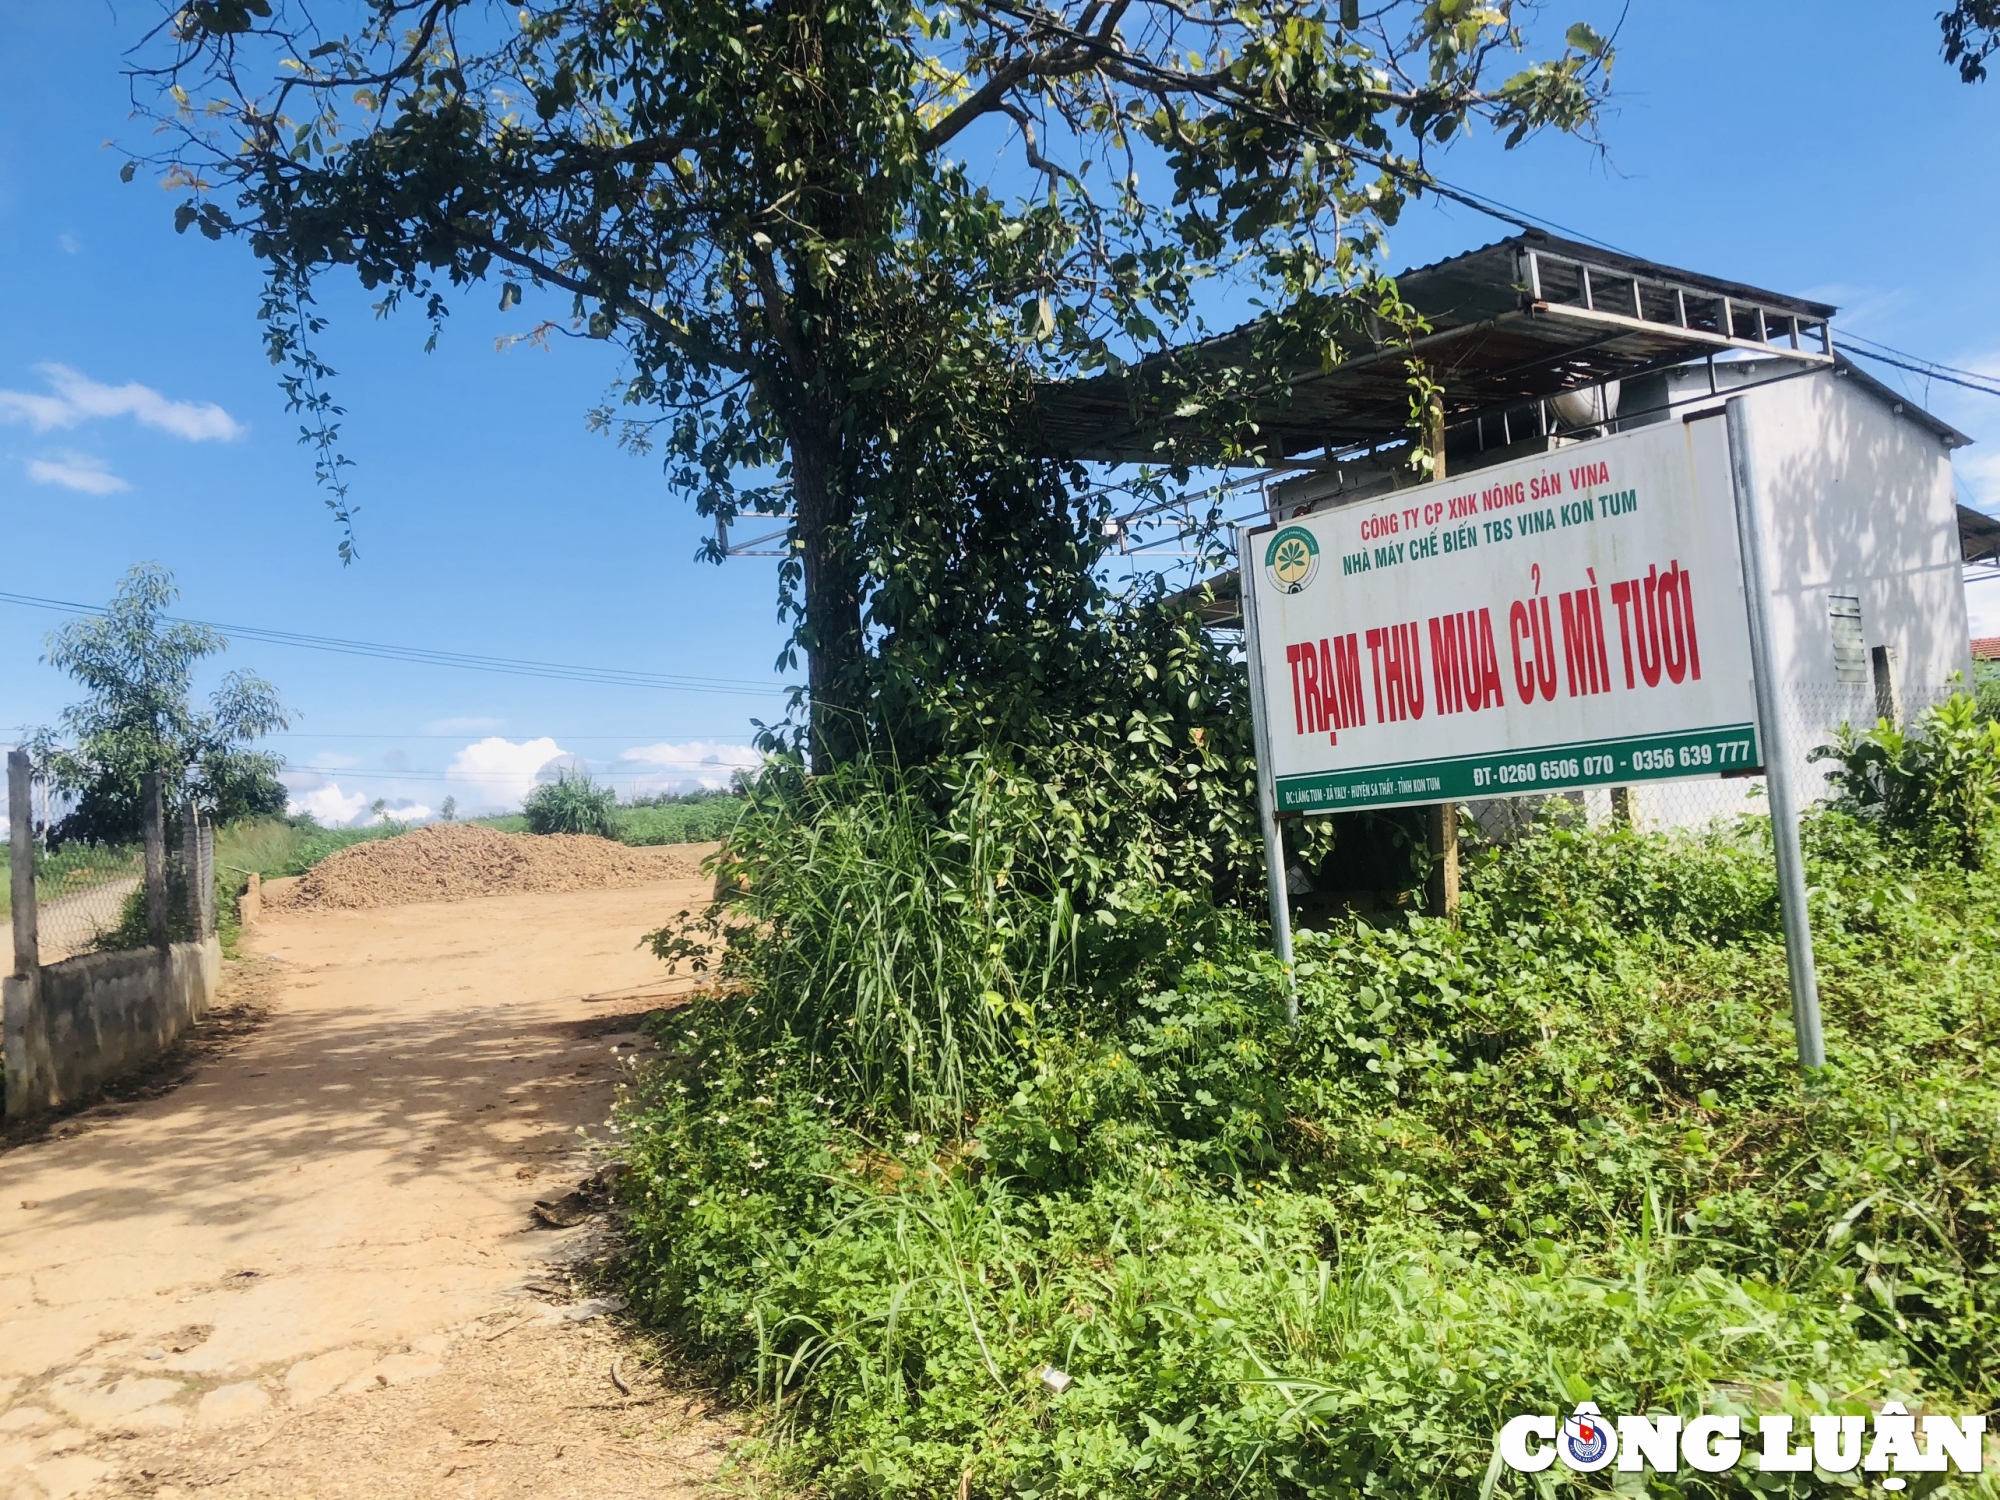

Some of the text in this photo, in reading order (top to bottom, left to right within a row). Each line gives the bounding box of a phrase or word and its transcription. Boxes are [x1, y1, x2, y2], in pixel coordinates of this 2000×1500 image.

[1342, 548, 1372, 576] NHÀ
[1375, 540, 1405, 567] MÁY
[1409, 527, 1439, 561] CHẾ
[1442, 521, 1478, 554] BIẾN
[1484, 516, 1513, 543] TBS
[1518, 508, 1557, 537] VINA
[1560, 499, 1594, 528] KON
[1599, 489, 1638, 517] TUM
[1360, 461, 1610, 541] CÔNG TY CP XNK NÔNG SẢN VINA
[1287, 560, 1702, 747] TRẠM THU MUA CỦ MÌ TƯƠI
[1310, 788, 1323, 802] TUM
[1370, 783, 1379, 797] SA
[1412, 778, 1426, 793] KON
[1426, 777, 1441, 791] TUM
[1541, 757, 1579, 780] 6506
[1583, 754, 1614, 776] 070
[1632, 747, 1675, 771] 0356
[1679, 744, 1713, 767] 639
[1716, 739, 1750, 763] 777
